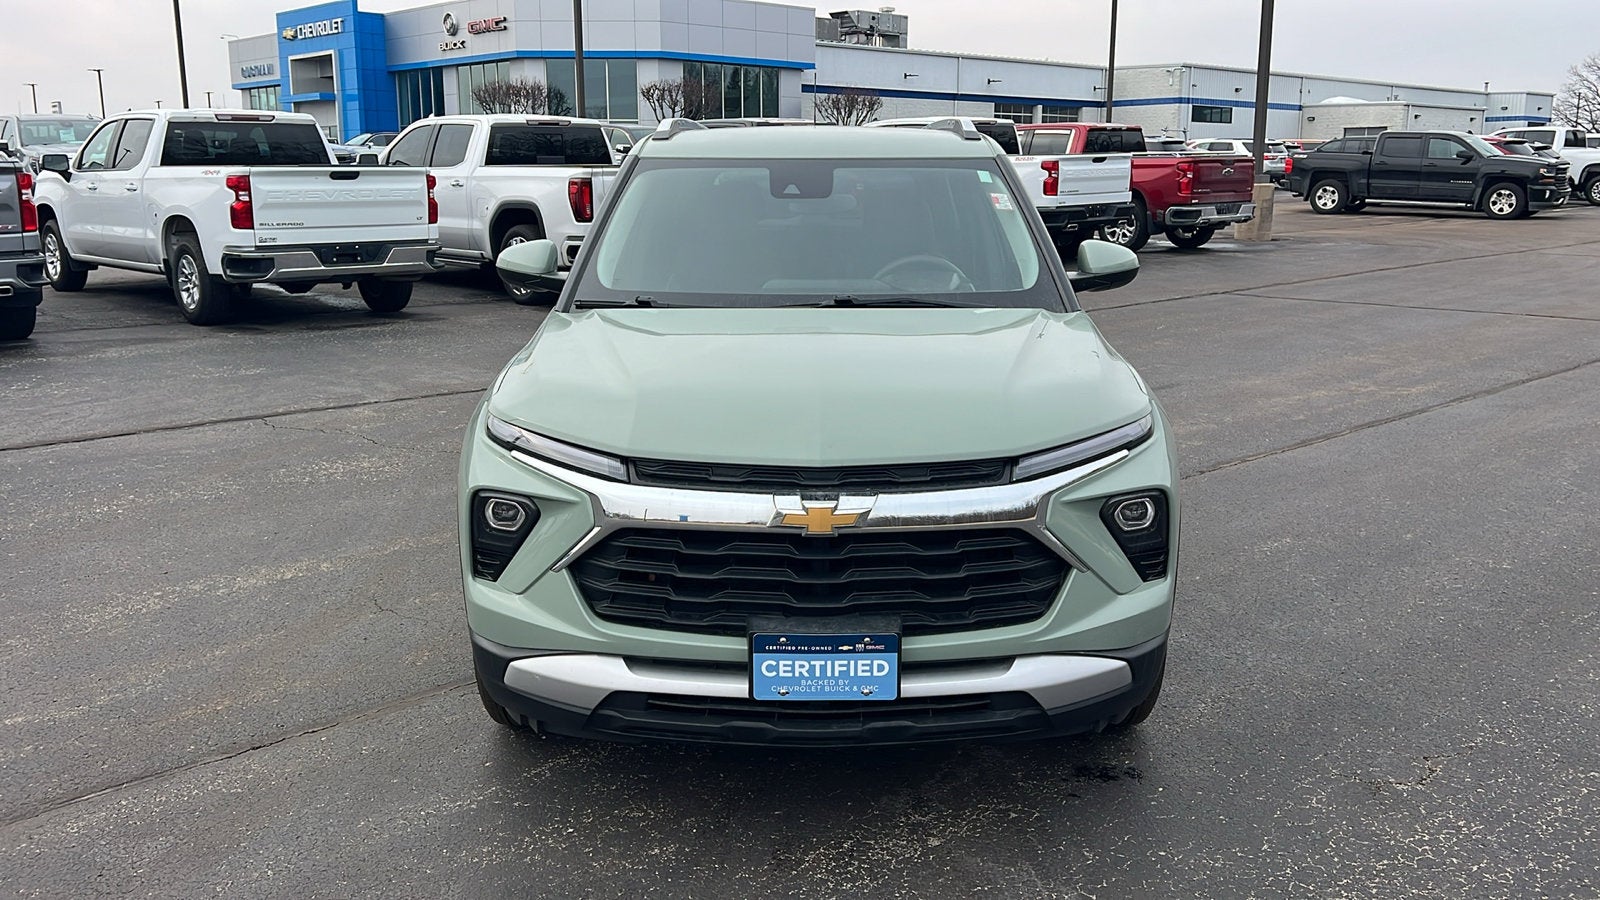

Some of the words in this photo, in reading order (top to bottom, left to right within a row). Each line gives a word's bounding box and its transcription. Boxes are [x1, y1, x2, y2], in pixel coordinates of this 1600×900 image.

[297, 18, 344, 39] CHEVROLET
[467, 17, 506, 34] GMC
[439, 39, 466, 51] BUICK
[266, 189, 418, 201] CHEVROLET
[761, 659, 890, 678] CERTIFIED
[771, 685, 821, 693] CHEVROLET
